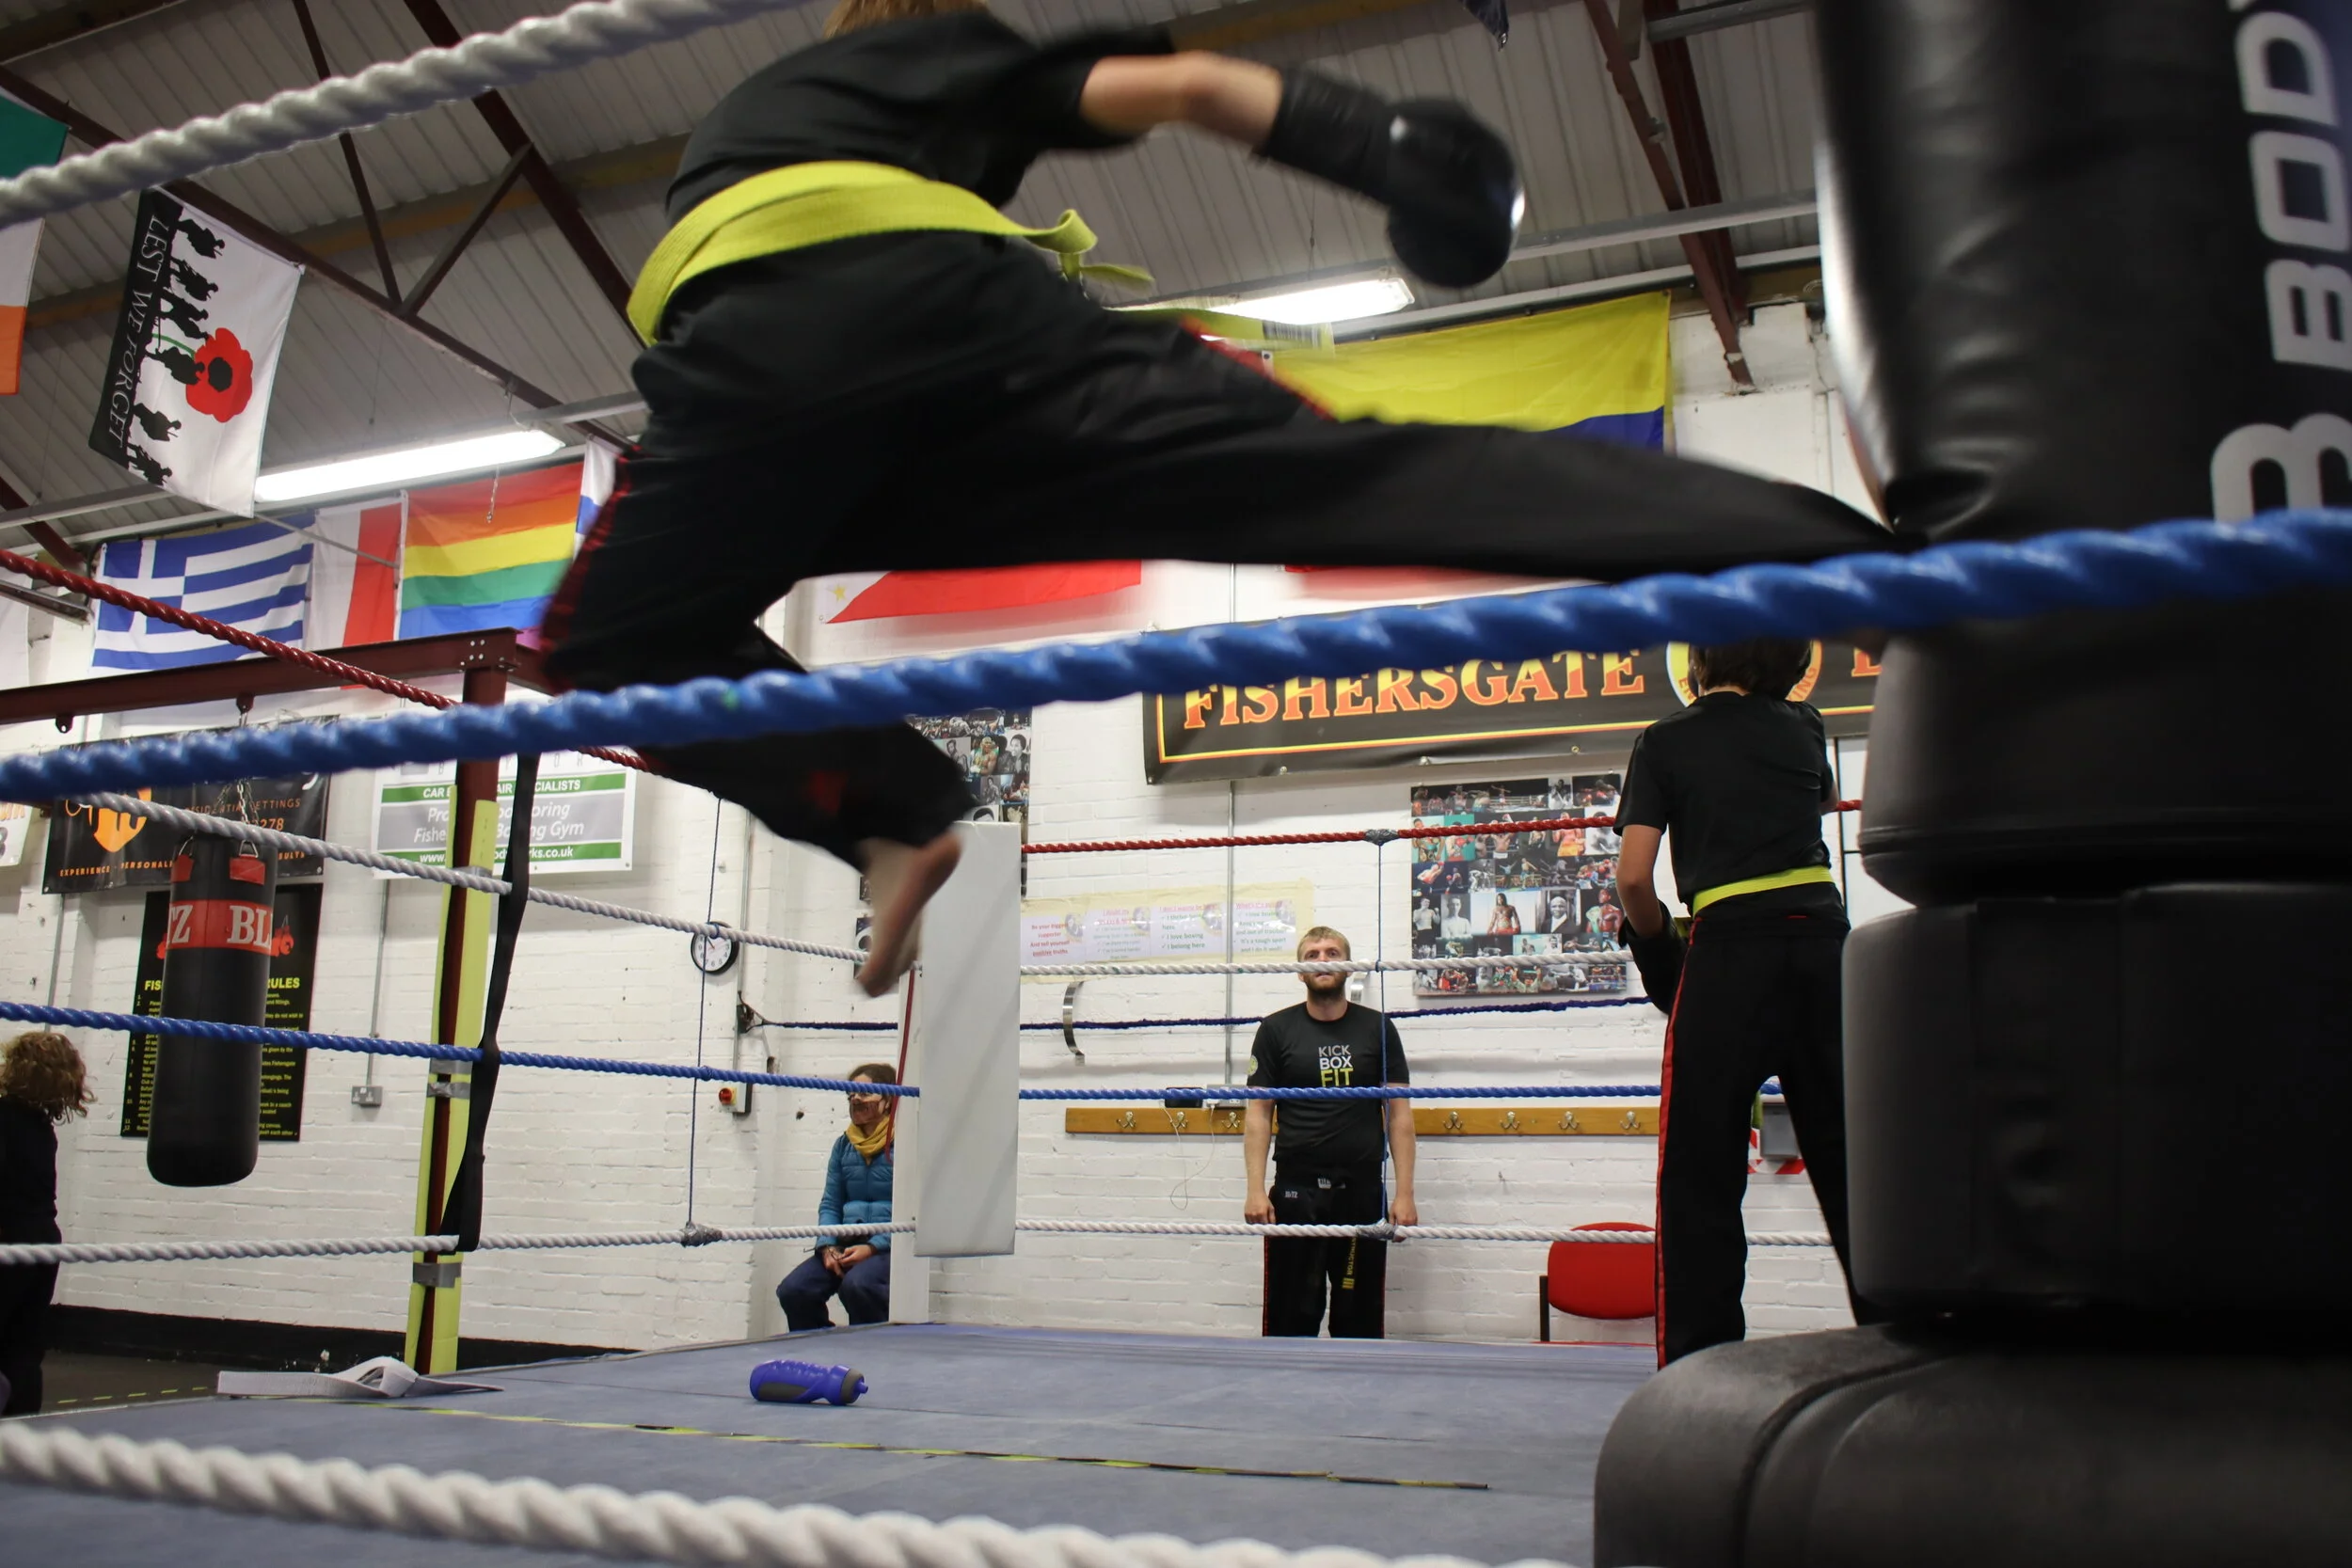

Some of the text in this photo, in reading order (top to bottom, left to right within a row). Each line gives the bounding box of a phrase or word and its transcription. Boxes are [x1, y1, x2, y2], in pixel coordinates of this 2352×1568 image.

[2227, 0, 2352, 371] BOD
[109, 214, 170, 449] LEST WE FORGET
[1184, 650, 1644, 729] FISHERSGATE
[422, 787, 445, 799] CAR
[534, 780, 581, 792] CIALISTS
[549, 820, 584, 840] Gym
[59, 865, 111, 877] EXPERIENCE
[120, 860, 174, 869] PERSONALI
[227, 905, 273, 948] BL
[1318, 1044, 1352, 1057] KICK
[1319, 1055, 1353, 1070] BOX
[1321, 1068, 1354, 1087] FIT
